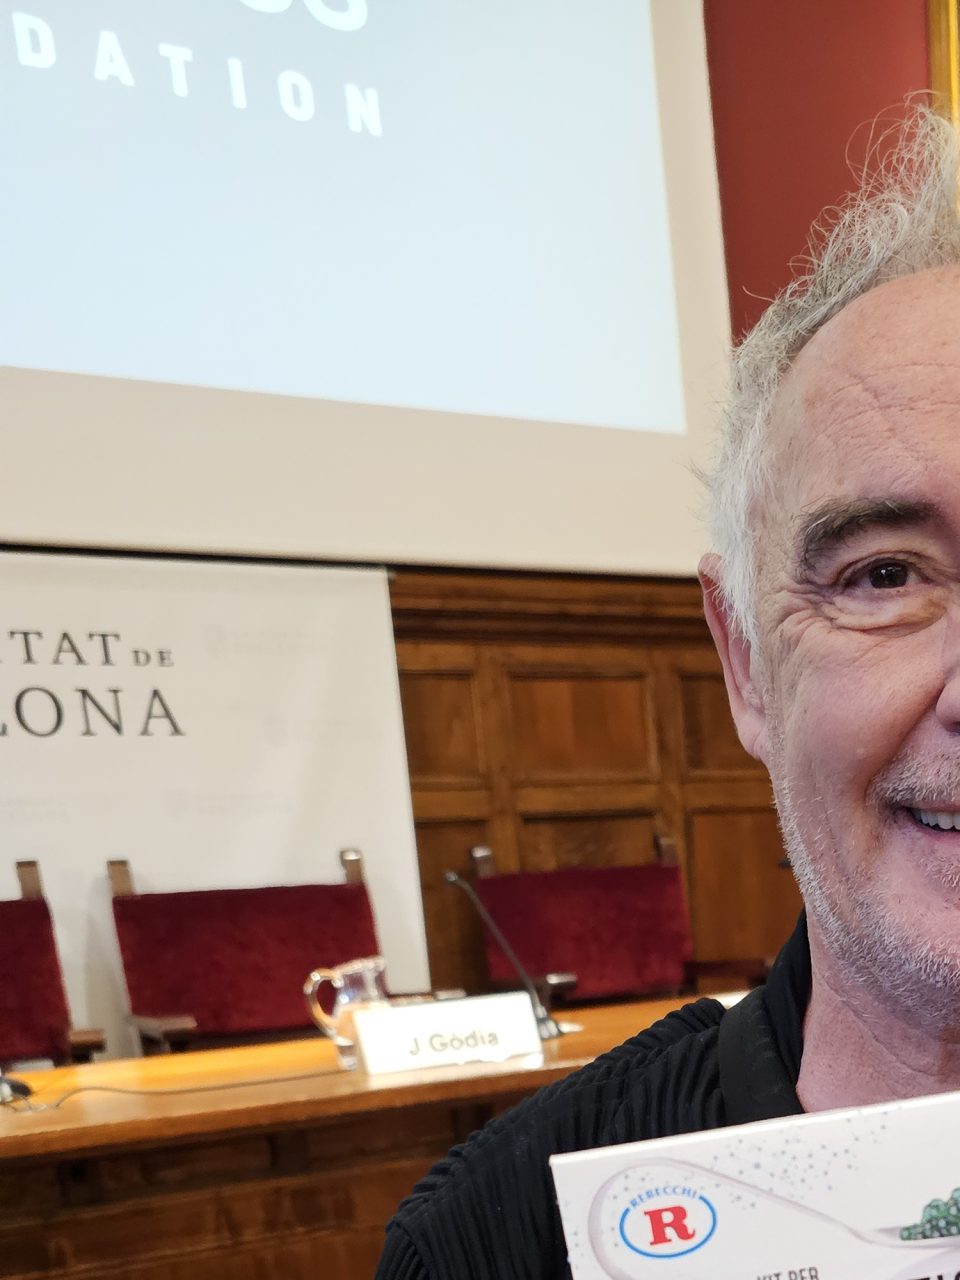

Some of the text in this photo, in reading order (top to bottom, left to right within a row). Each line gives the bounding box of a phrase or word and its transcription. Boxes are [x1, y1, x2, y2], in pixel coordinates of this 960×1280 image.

[12, 11, 382, 136] DATION
[131, 650, 174, 667] DE
[0, 686, 187, 738] ONA
[408, 1036, 421, 1057] J
[643, 1205, 697, 1247] R
